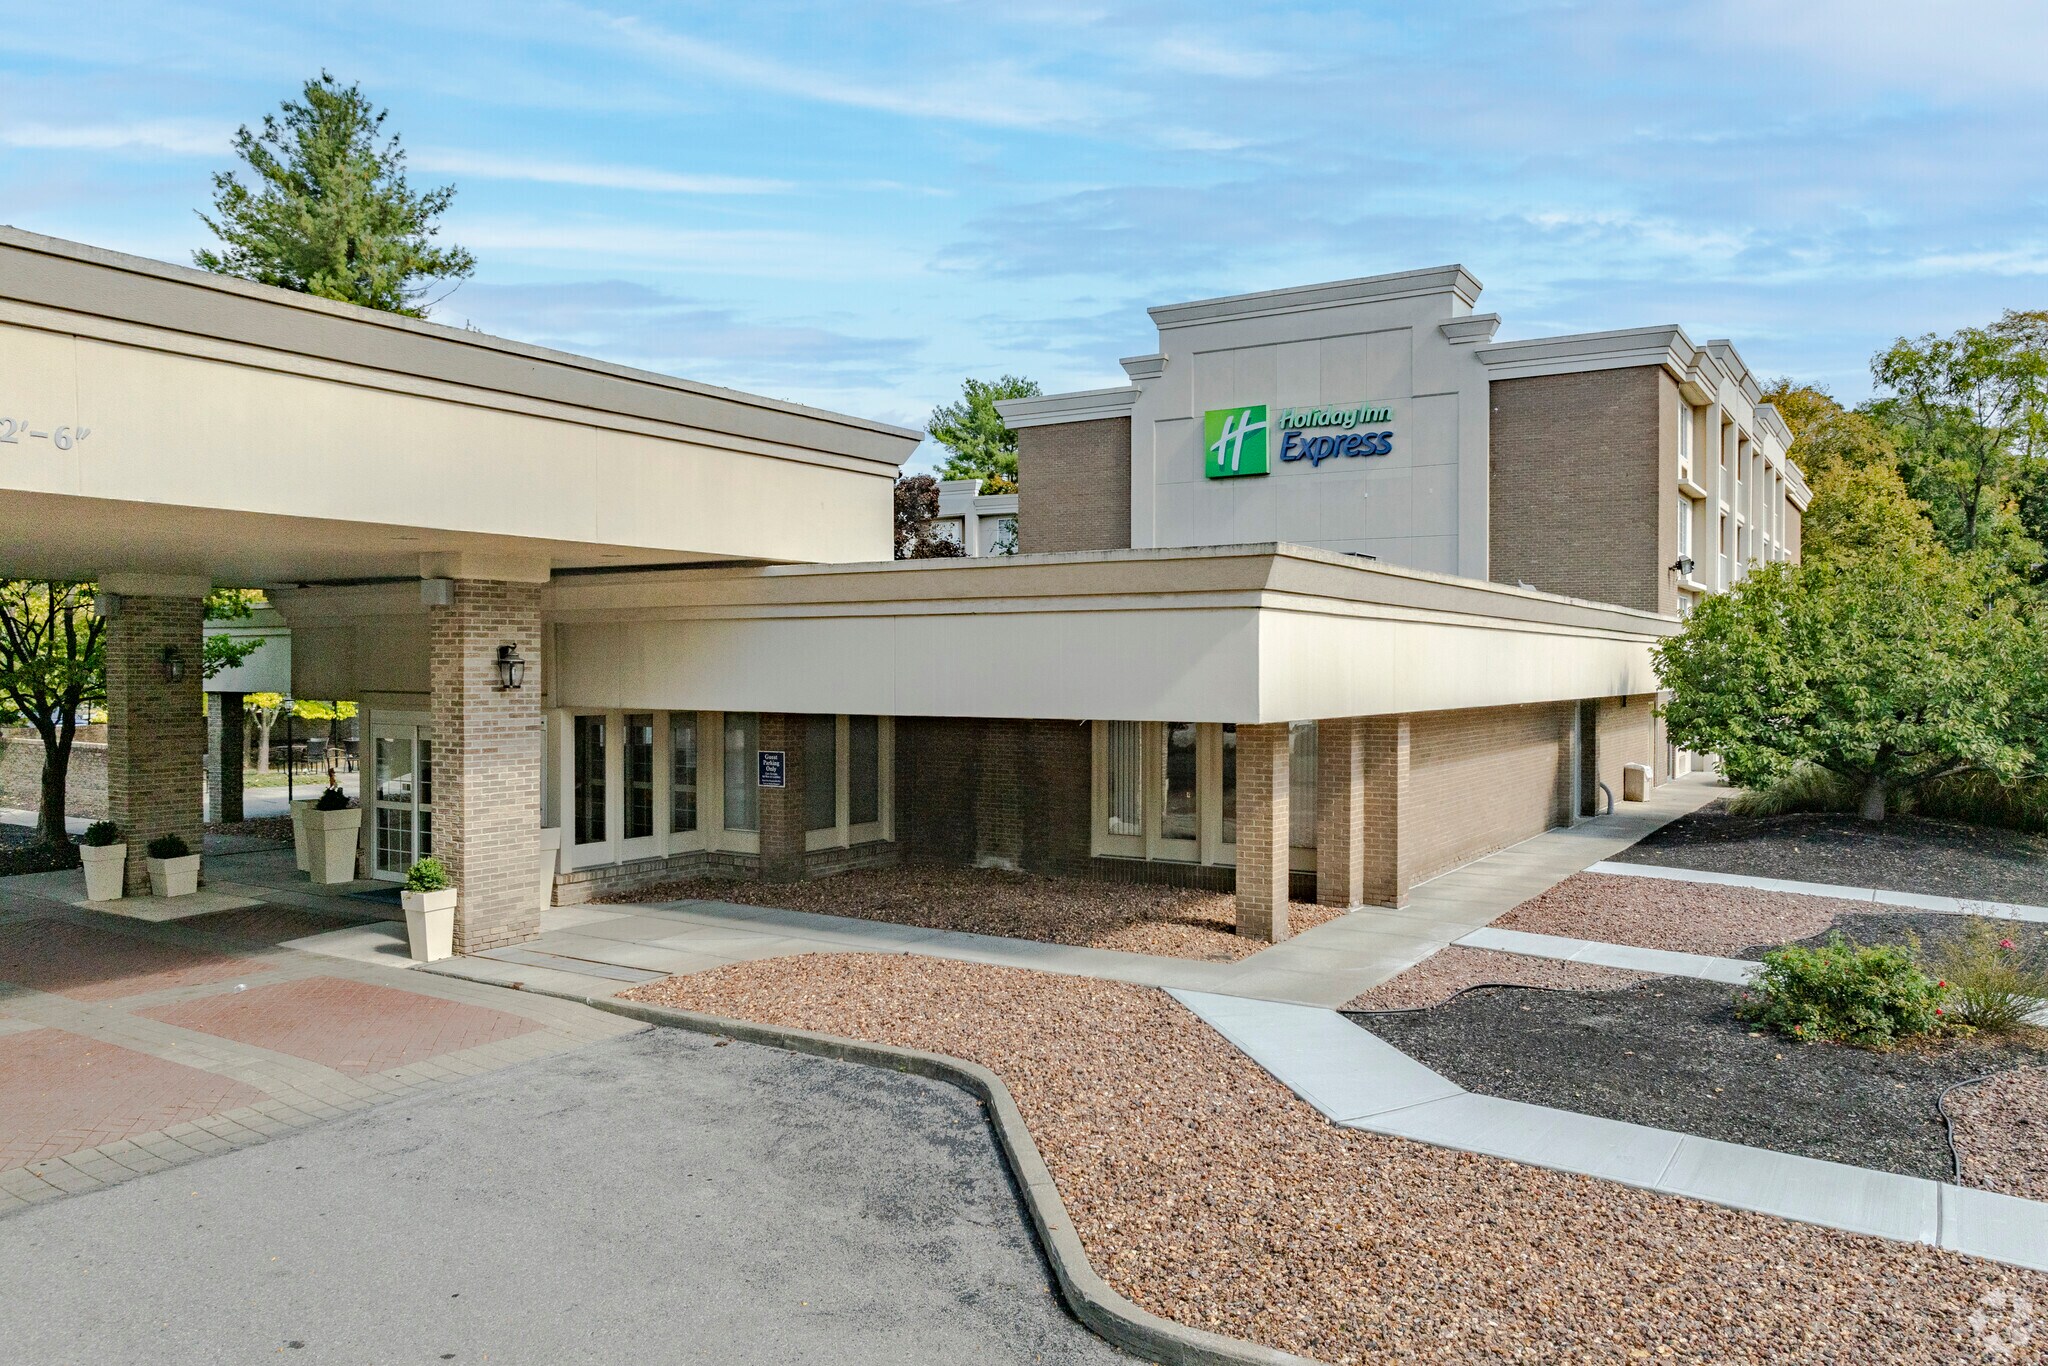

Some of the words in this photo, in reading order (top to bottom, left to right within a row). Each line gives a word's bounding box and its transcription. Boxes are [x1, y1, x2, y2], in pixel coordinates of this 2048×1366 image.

[1280, 406, 1358, 429] Holiday
[1360, 403, 1393, 423] Inn
[1280, 431, 1393, 467] Express
